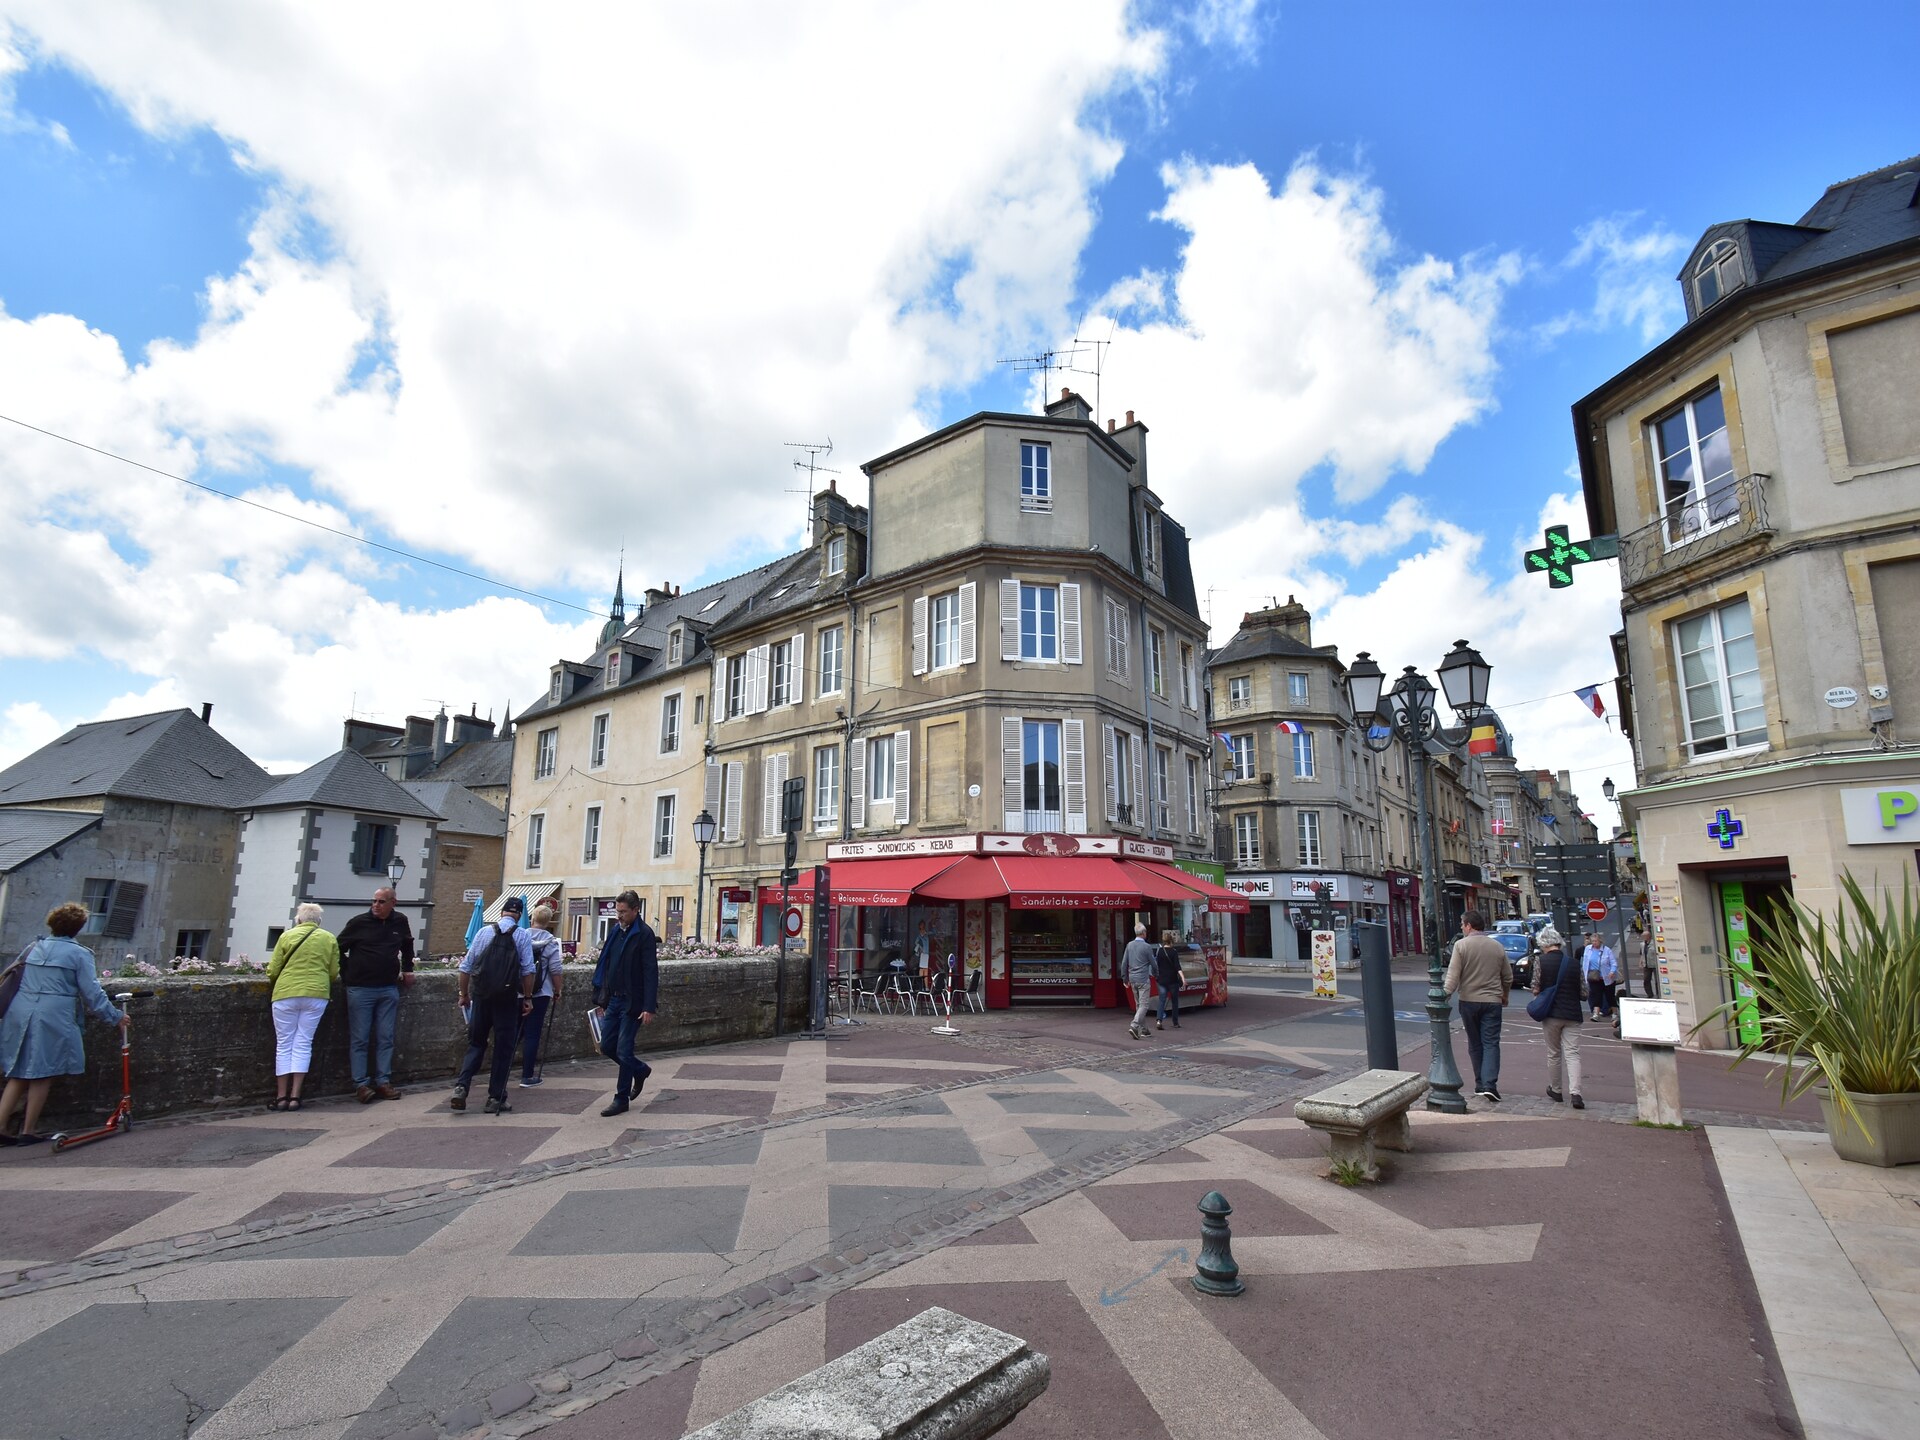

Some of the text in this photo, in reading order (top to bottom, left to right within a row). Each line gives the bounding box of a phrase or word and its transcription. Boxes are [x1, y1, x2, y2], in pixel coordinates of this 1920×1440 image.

[1877, 791, 1919, 828] P
[841, 845, 864, 855] FRITES
[877, 842, 916, 853] SANDWICHS
[930, 840, 953, 850] KEBAB
[1152, 846, 1166, 857] KEBAB
[776, 892, 797, 902] Crpes
[838, 893, 866, 903] Boissons
[872, 893, 897, 903] Glaces
[1020, 896, 1079, 906] Sandwiches
[1093, 896, 1131, 906] Salades
